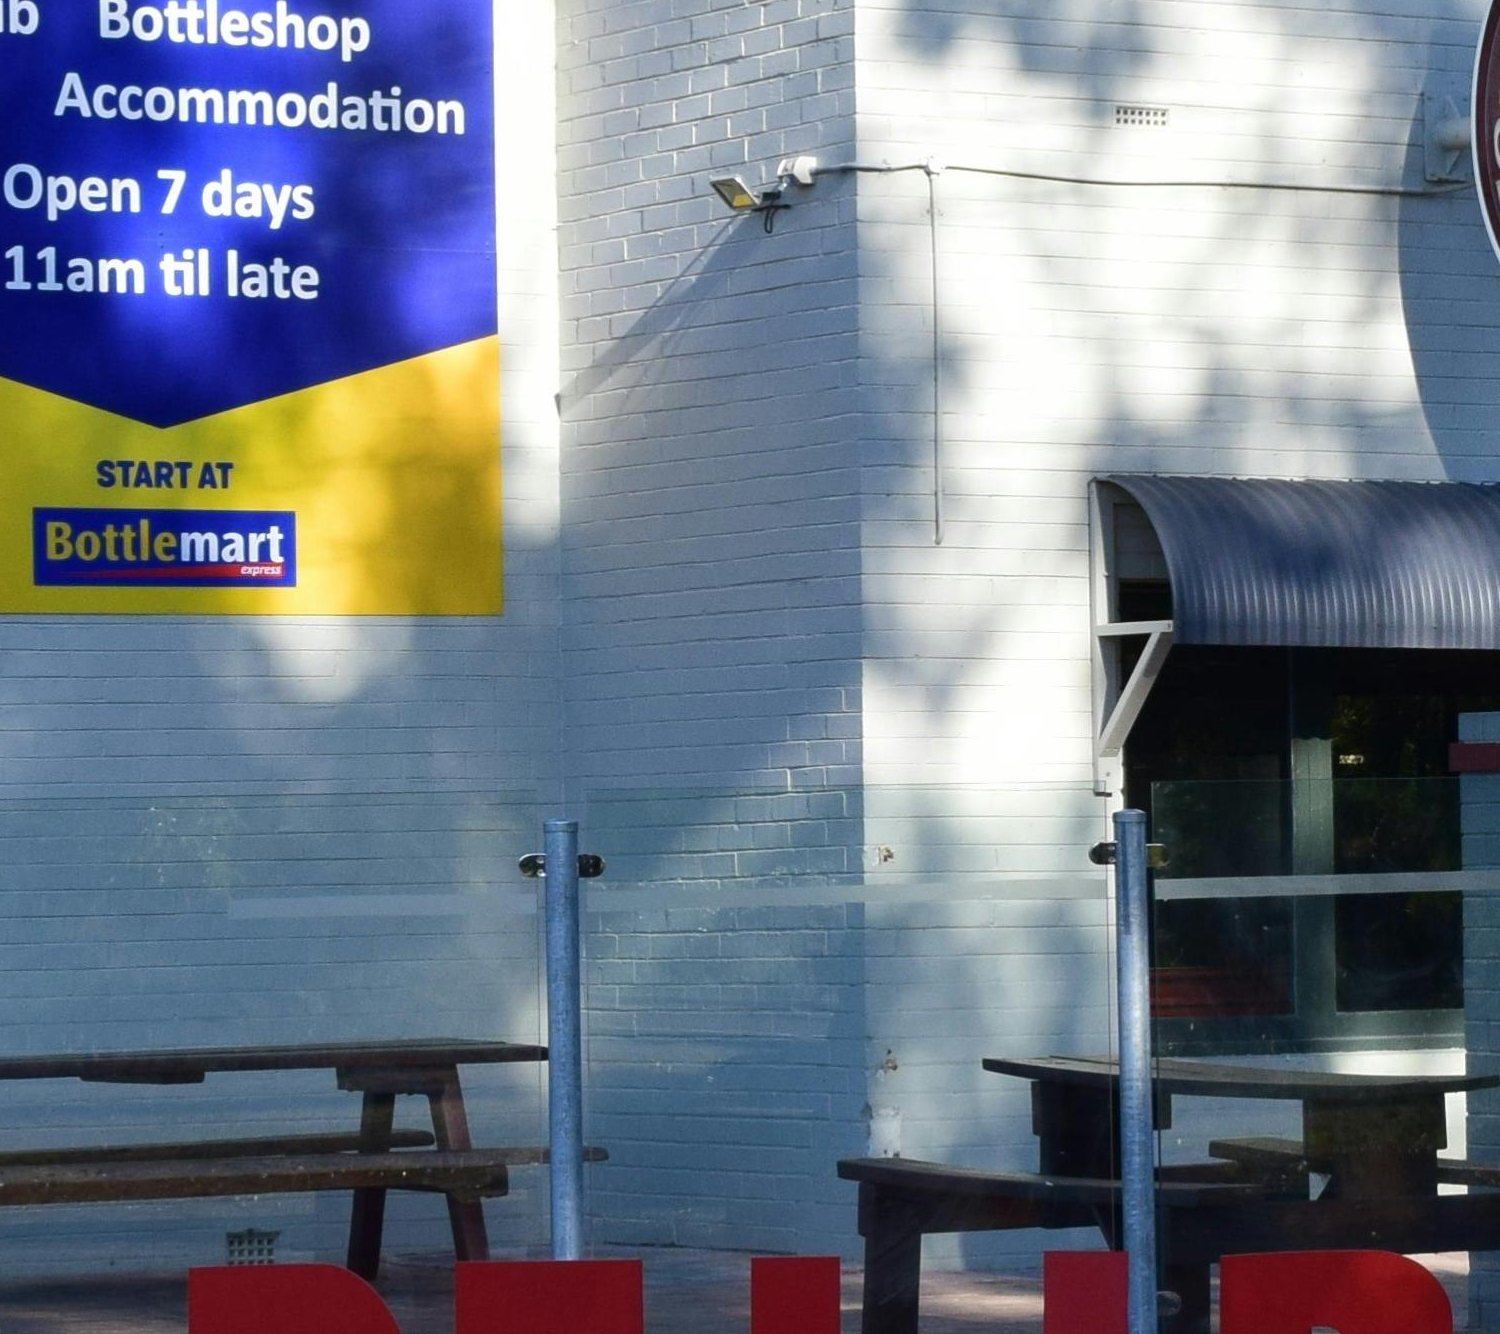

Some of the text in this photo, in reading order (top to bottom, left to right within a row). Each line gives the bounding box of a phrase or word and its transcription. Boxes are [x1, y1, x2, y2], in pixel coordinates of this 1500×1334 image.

[54, 72, 466, 135] Accommodation
[3, 163, 316, 230] Open 7 days
[4, 245, 321, 299] 11am til late
[96, 460, 234, 489] START AT
[45, 519, 285, 563] Bottlemart
[240, 564, 282, 577] express
